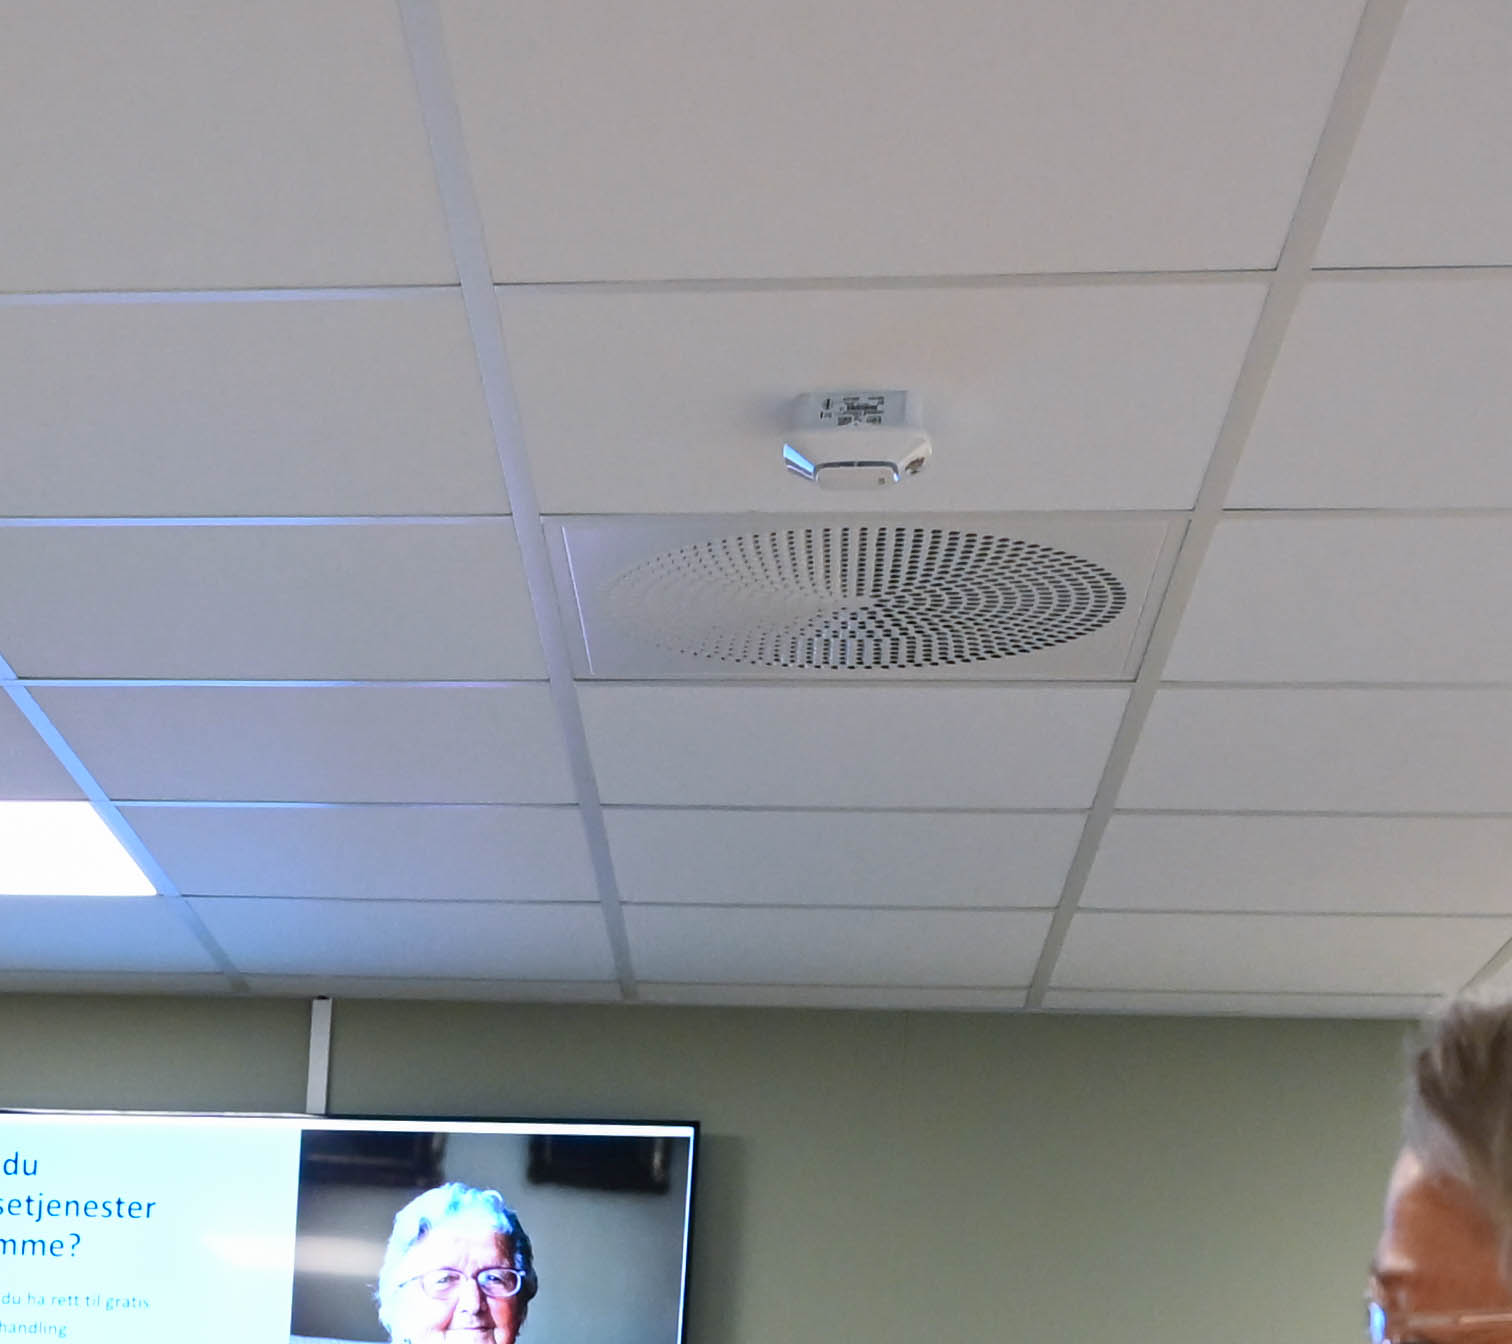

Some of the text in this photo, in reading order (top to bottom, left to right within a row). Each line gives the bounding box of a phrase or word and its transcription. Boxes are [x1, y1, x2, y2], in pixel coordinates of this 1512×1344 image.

[3, 1151, 38, 1176] du
[1, 1292, 22, 1305] du
[27, 1293, 45, 1306] ha
[51, 1294, 79, 1307] rett
[85, 1294, 101, 1308] til
[105, 1297, 150, 1311] gratis
